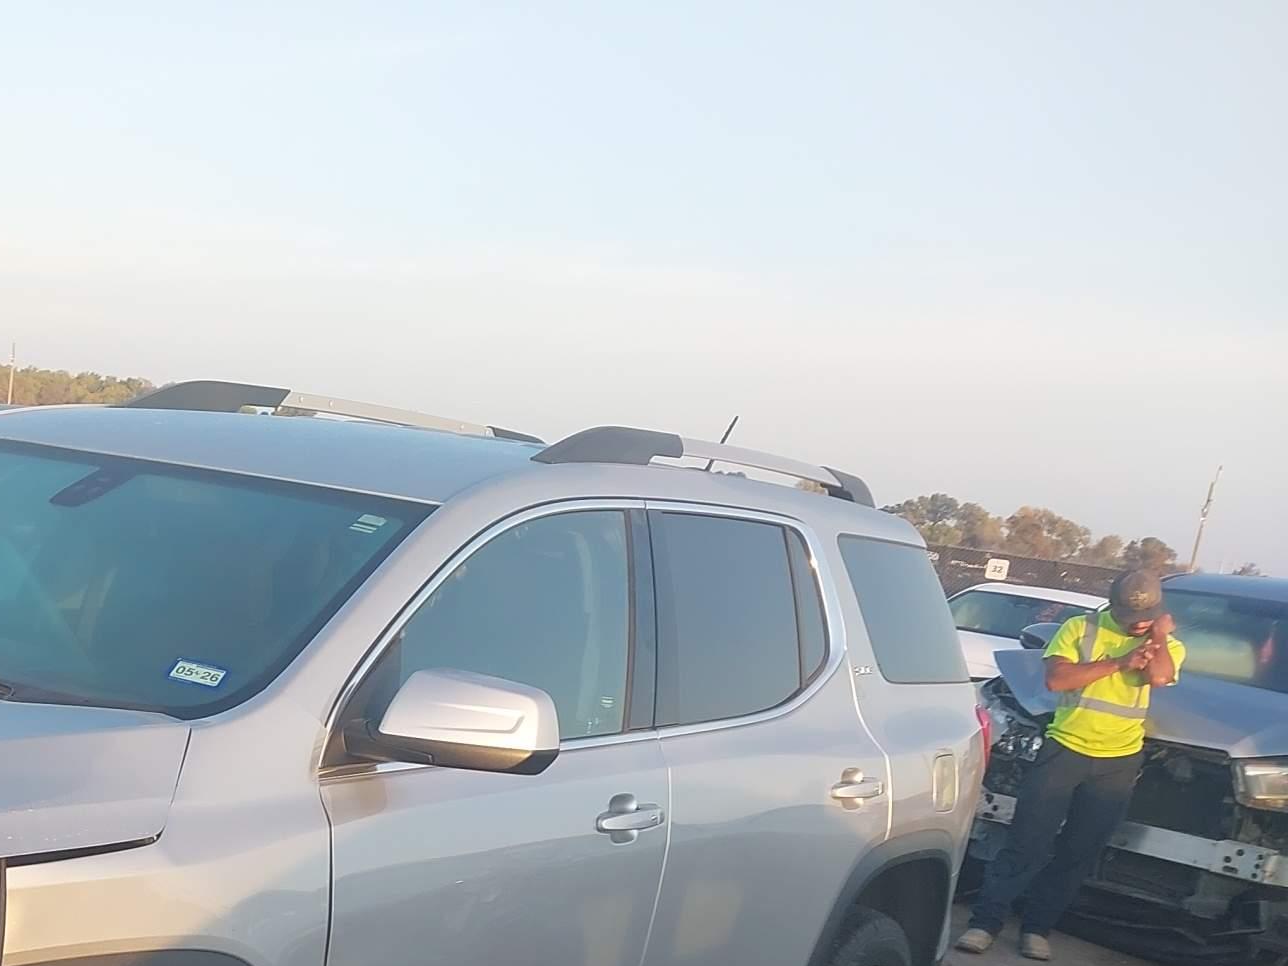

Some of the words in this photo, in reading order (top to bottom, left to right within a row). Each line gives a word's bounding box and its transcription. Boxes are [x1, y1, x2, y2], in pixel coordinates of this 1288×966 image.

[991, 564, 1003, 574] 32
[175, 665, 195, 676] 05
[200, 671, 221, 682] 26
